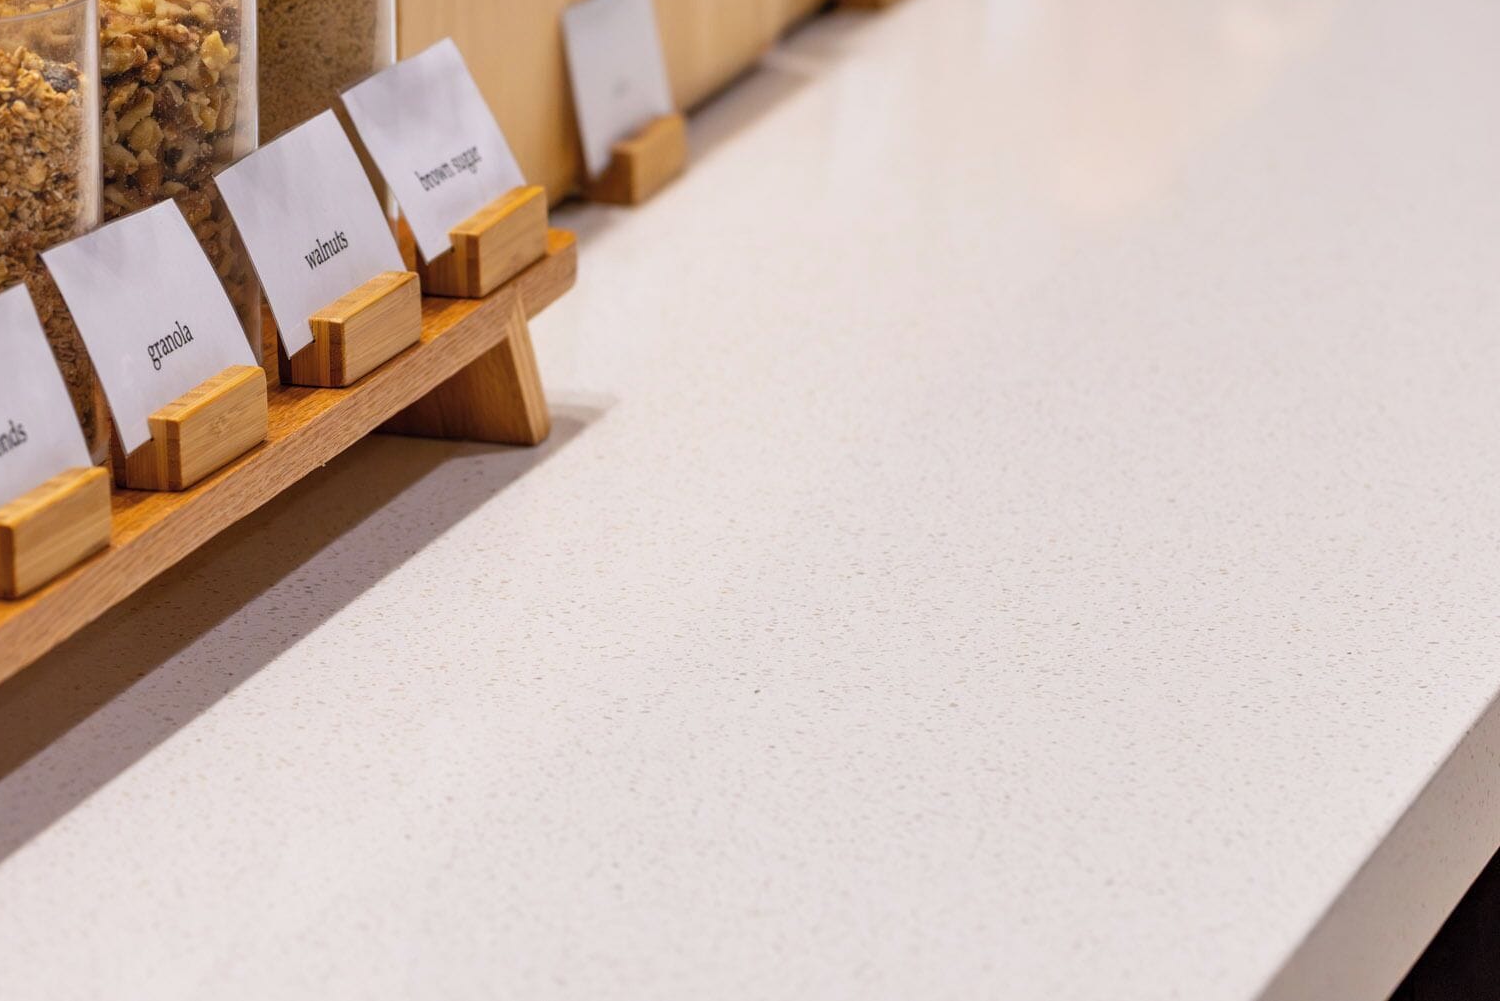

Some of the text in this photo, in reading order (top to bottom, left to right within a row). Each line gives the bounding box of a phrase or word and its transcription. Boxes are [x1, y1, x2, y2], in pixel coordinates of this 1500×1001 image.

[414, 146, 482, 192] brown sugar
[304, 230, 349, 270] walnuts
[147, 320, 195, 371] granola
